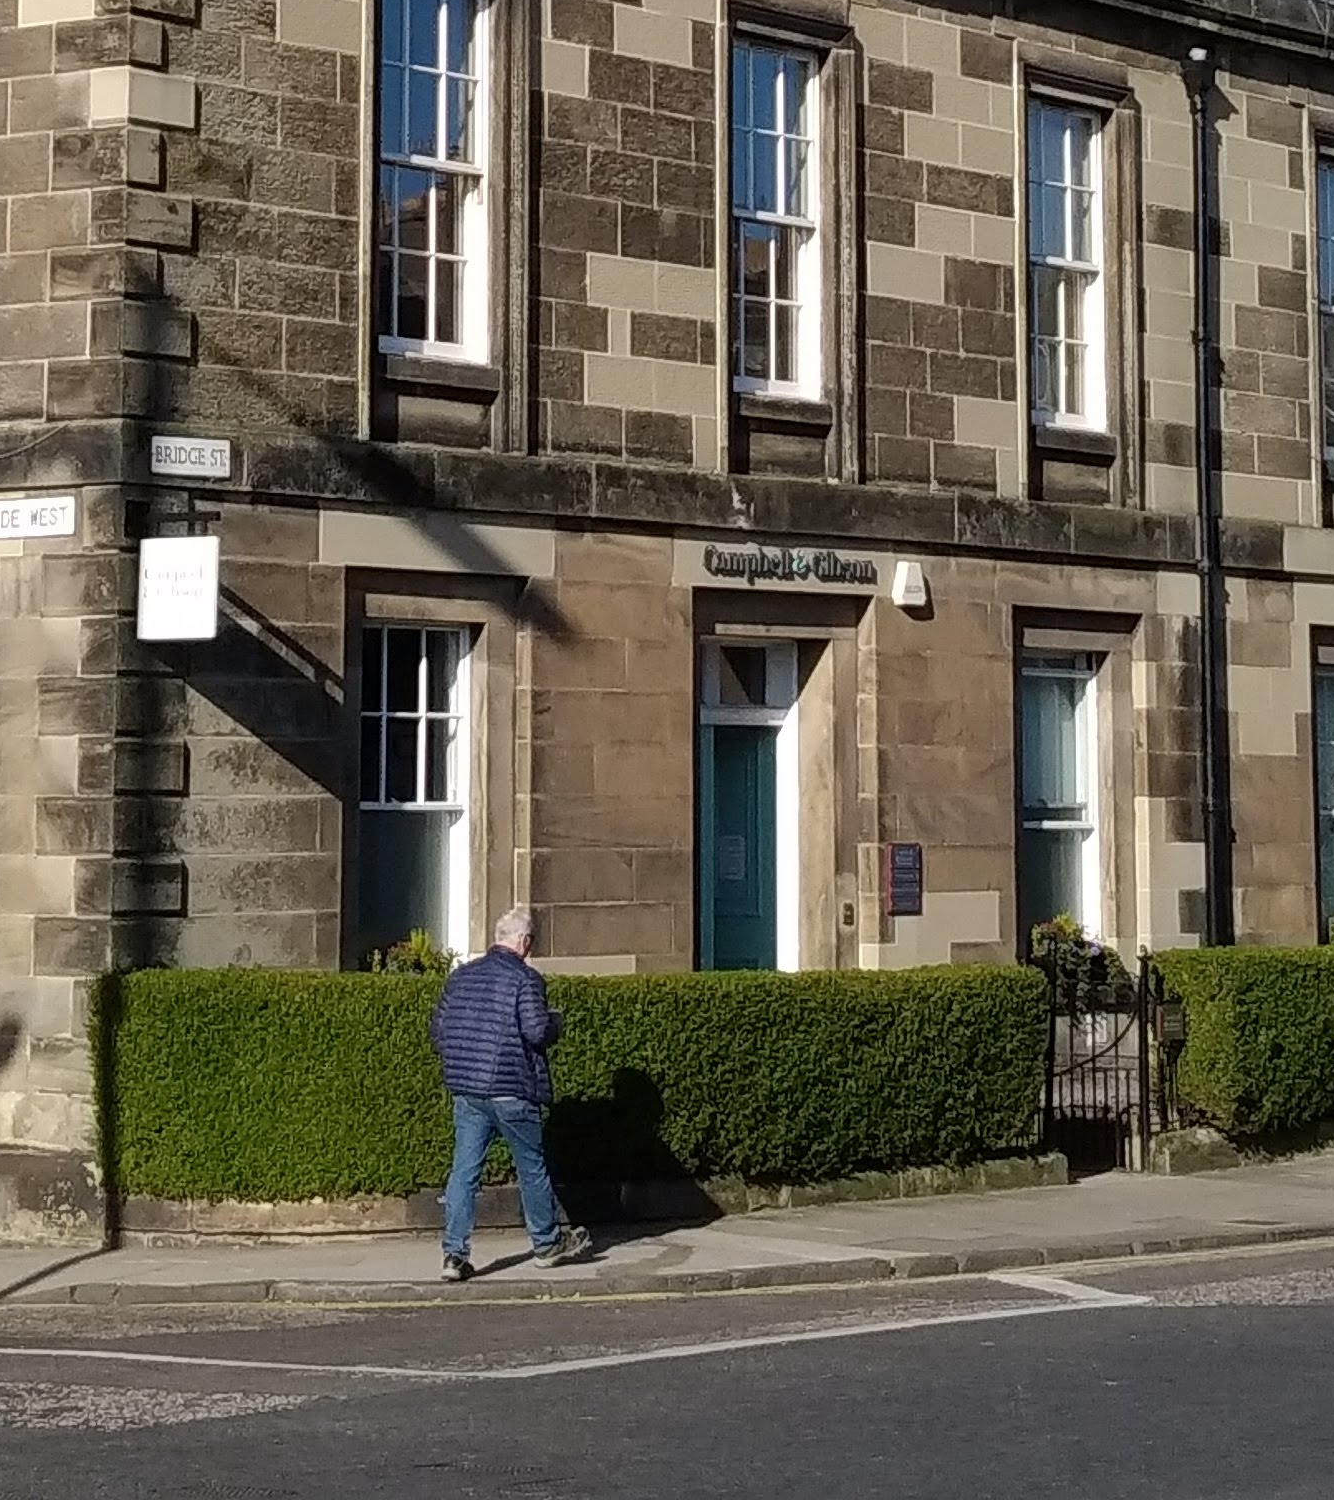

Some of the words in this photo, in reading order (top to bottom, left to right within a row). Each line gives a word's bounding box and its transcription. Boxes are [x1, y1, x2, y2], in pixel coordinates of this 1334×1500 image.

[155, 444, 206, 466] BRIDGE
[30, 505, 69, 527] WEST
[704, 543, 793, 585] Campbell
[808, 551, 878, 585] Gibson
